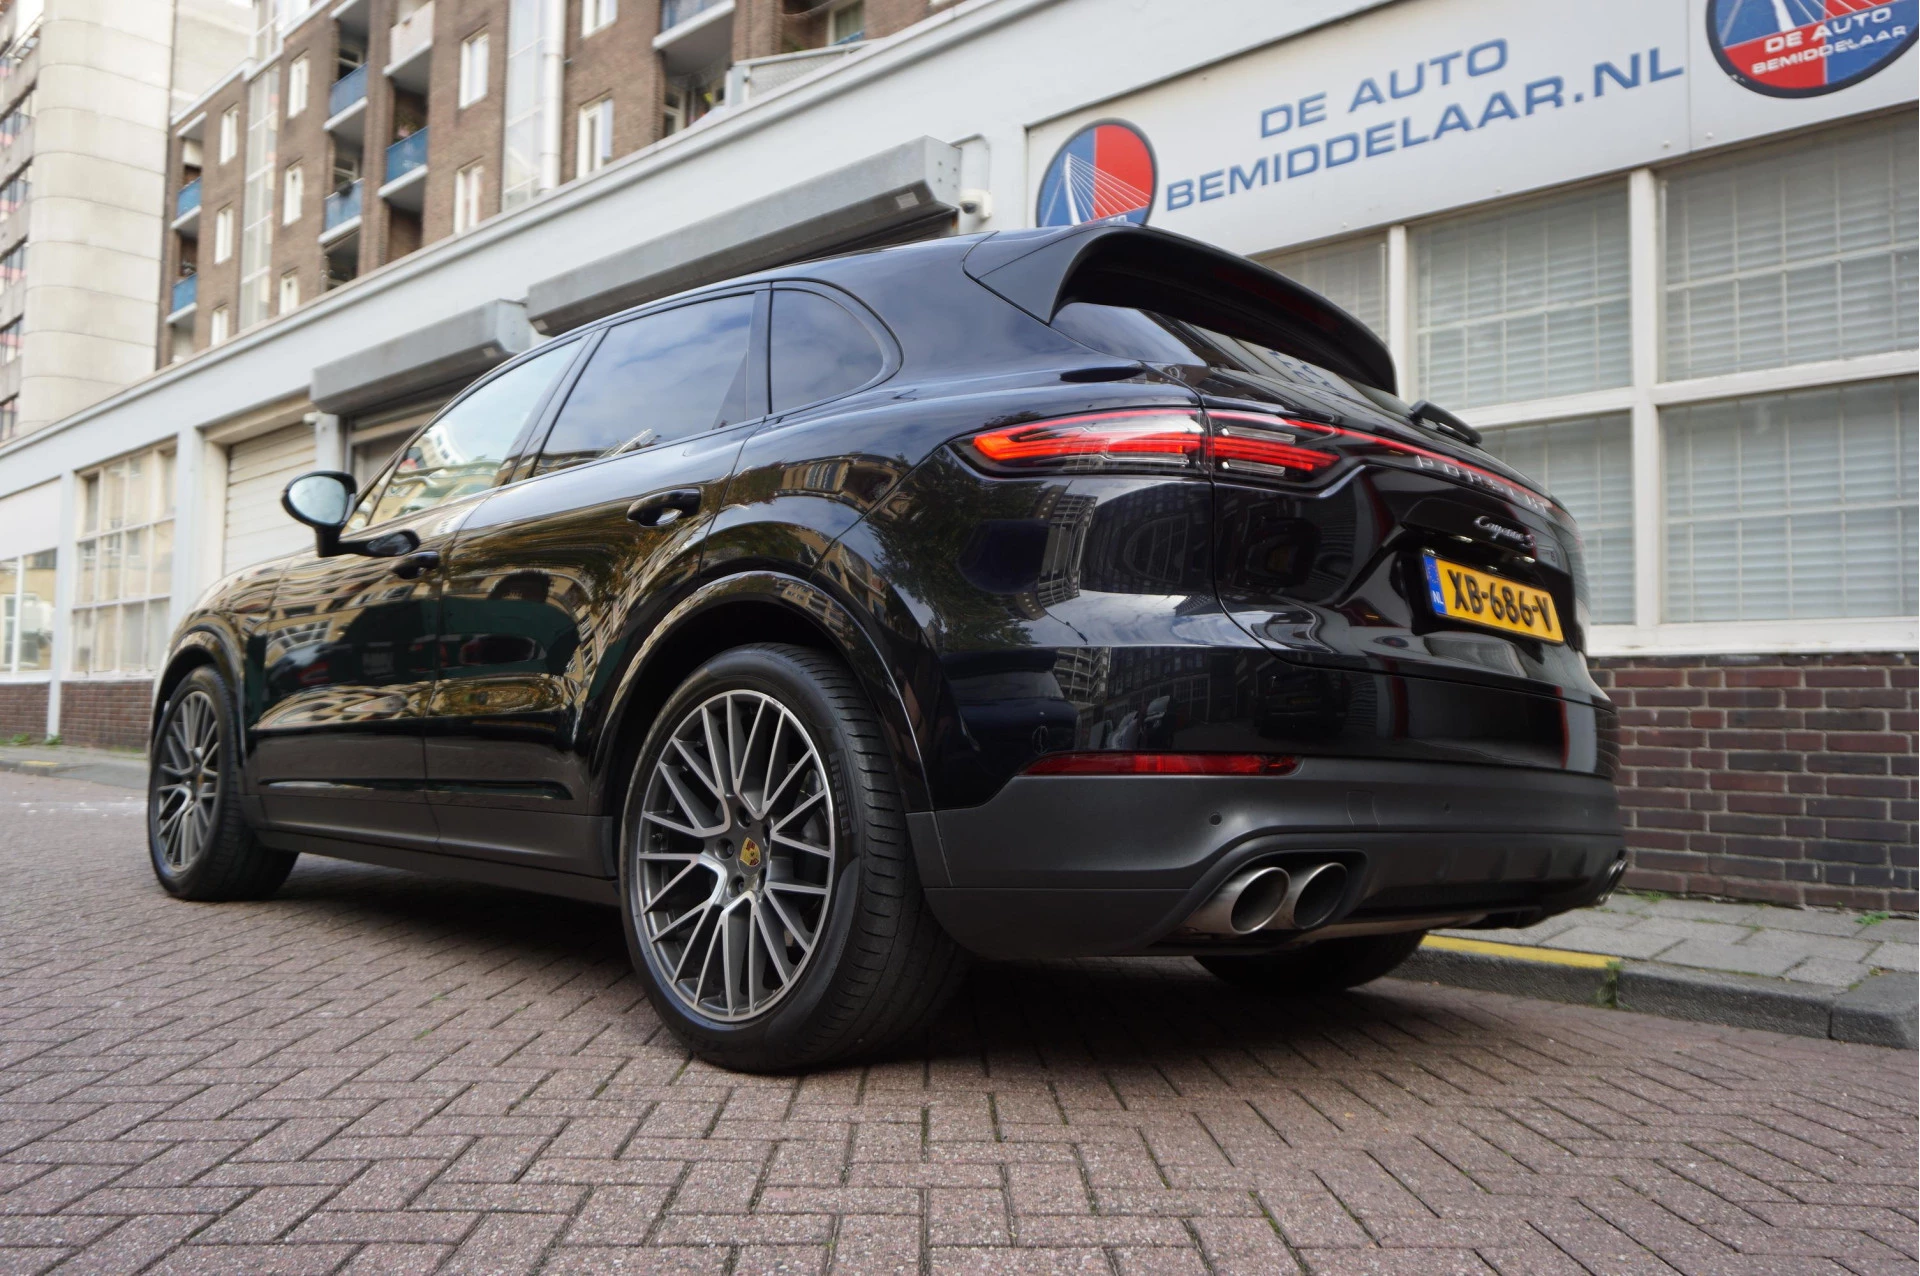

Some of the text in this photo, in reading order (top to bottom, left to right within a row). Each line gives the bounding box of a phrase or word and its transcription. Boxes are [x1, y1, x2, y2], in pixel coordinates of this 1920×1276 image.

[1752, 25, 1908, 75] BEMIDDELAAR
[1764, 6, 1893, 54] DE AUTO
[1260, 37, 1509, 138] DE AUTO
[1166, 46, 1685, 212] BEMIDDELAAR.NL
[1432, 590, 1445, 605] NL
[1447, 569, 1553, 632] XB-686-V
